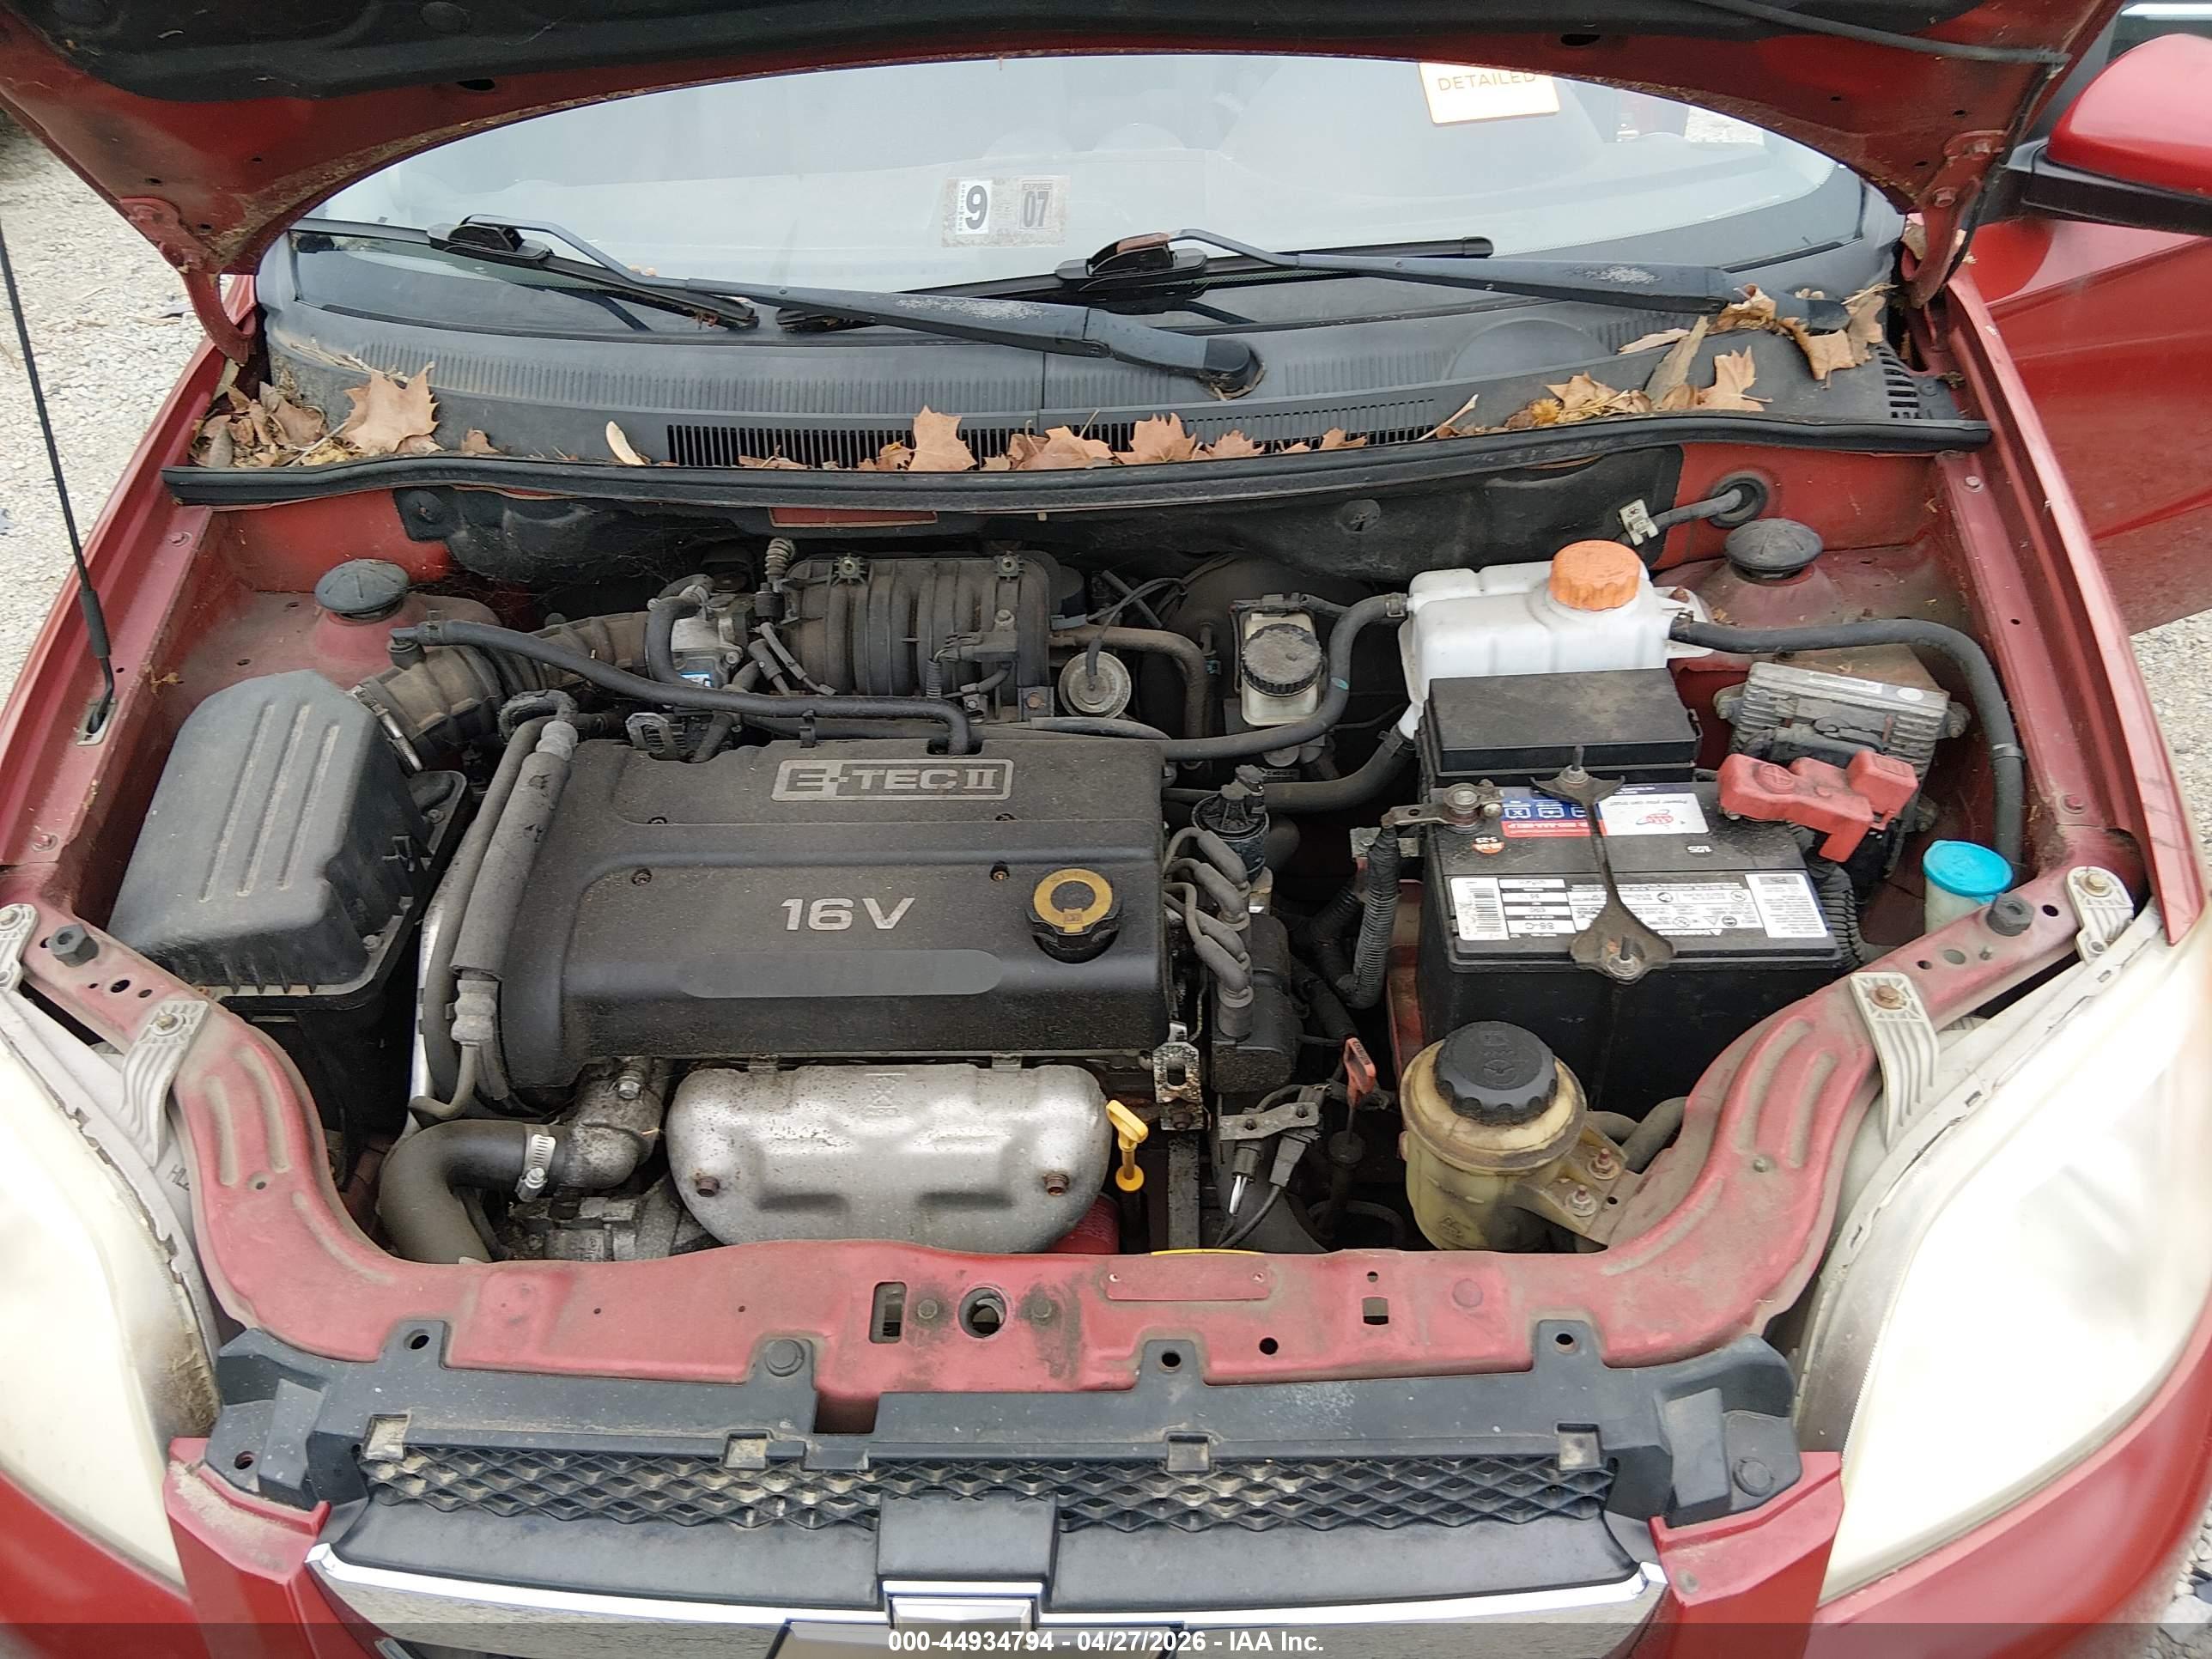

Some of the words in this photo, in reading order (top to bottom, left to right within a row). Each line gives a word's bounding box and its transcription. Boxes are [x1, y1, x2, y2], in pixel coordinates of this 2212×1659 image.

[1437, 72, 1536, 91] DETAILED
[965, 185, 988, 230] 9
[1023, 191, 1049, 228] 07
[780, 897, 915, 932] 16V
